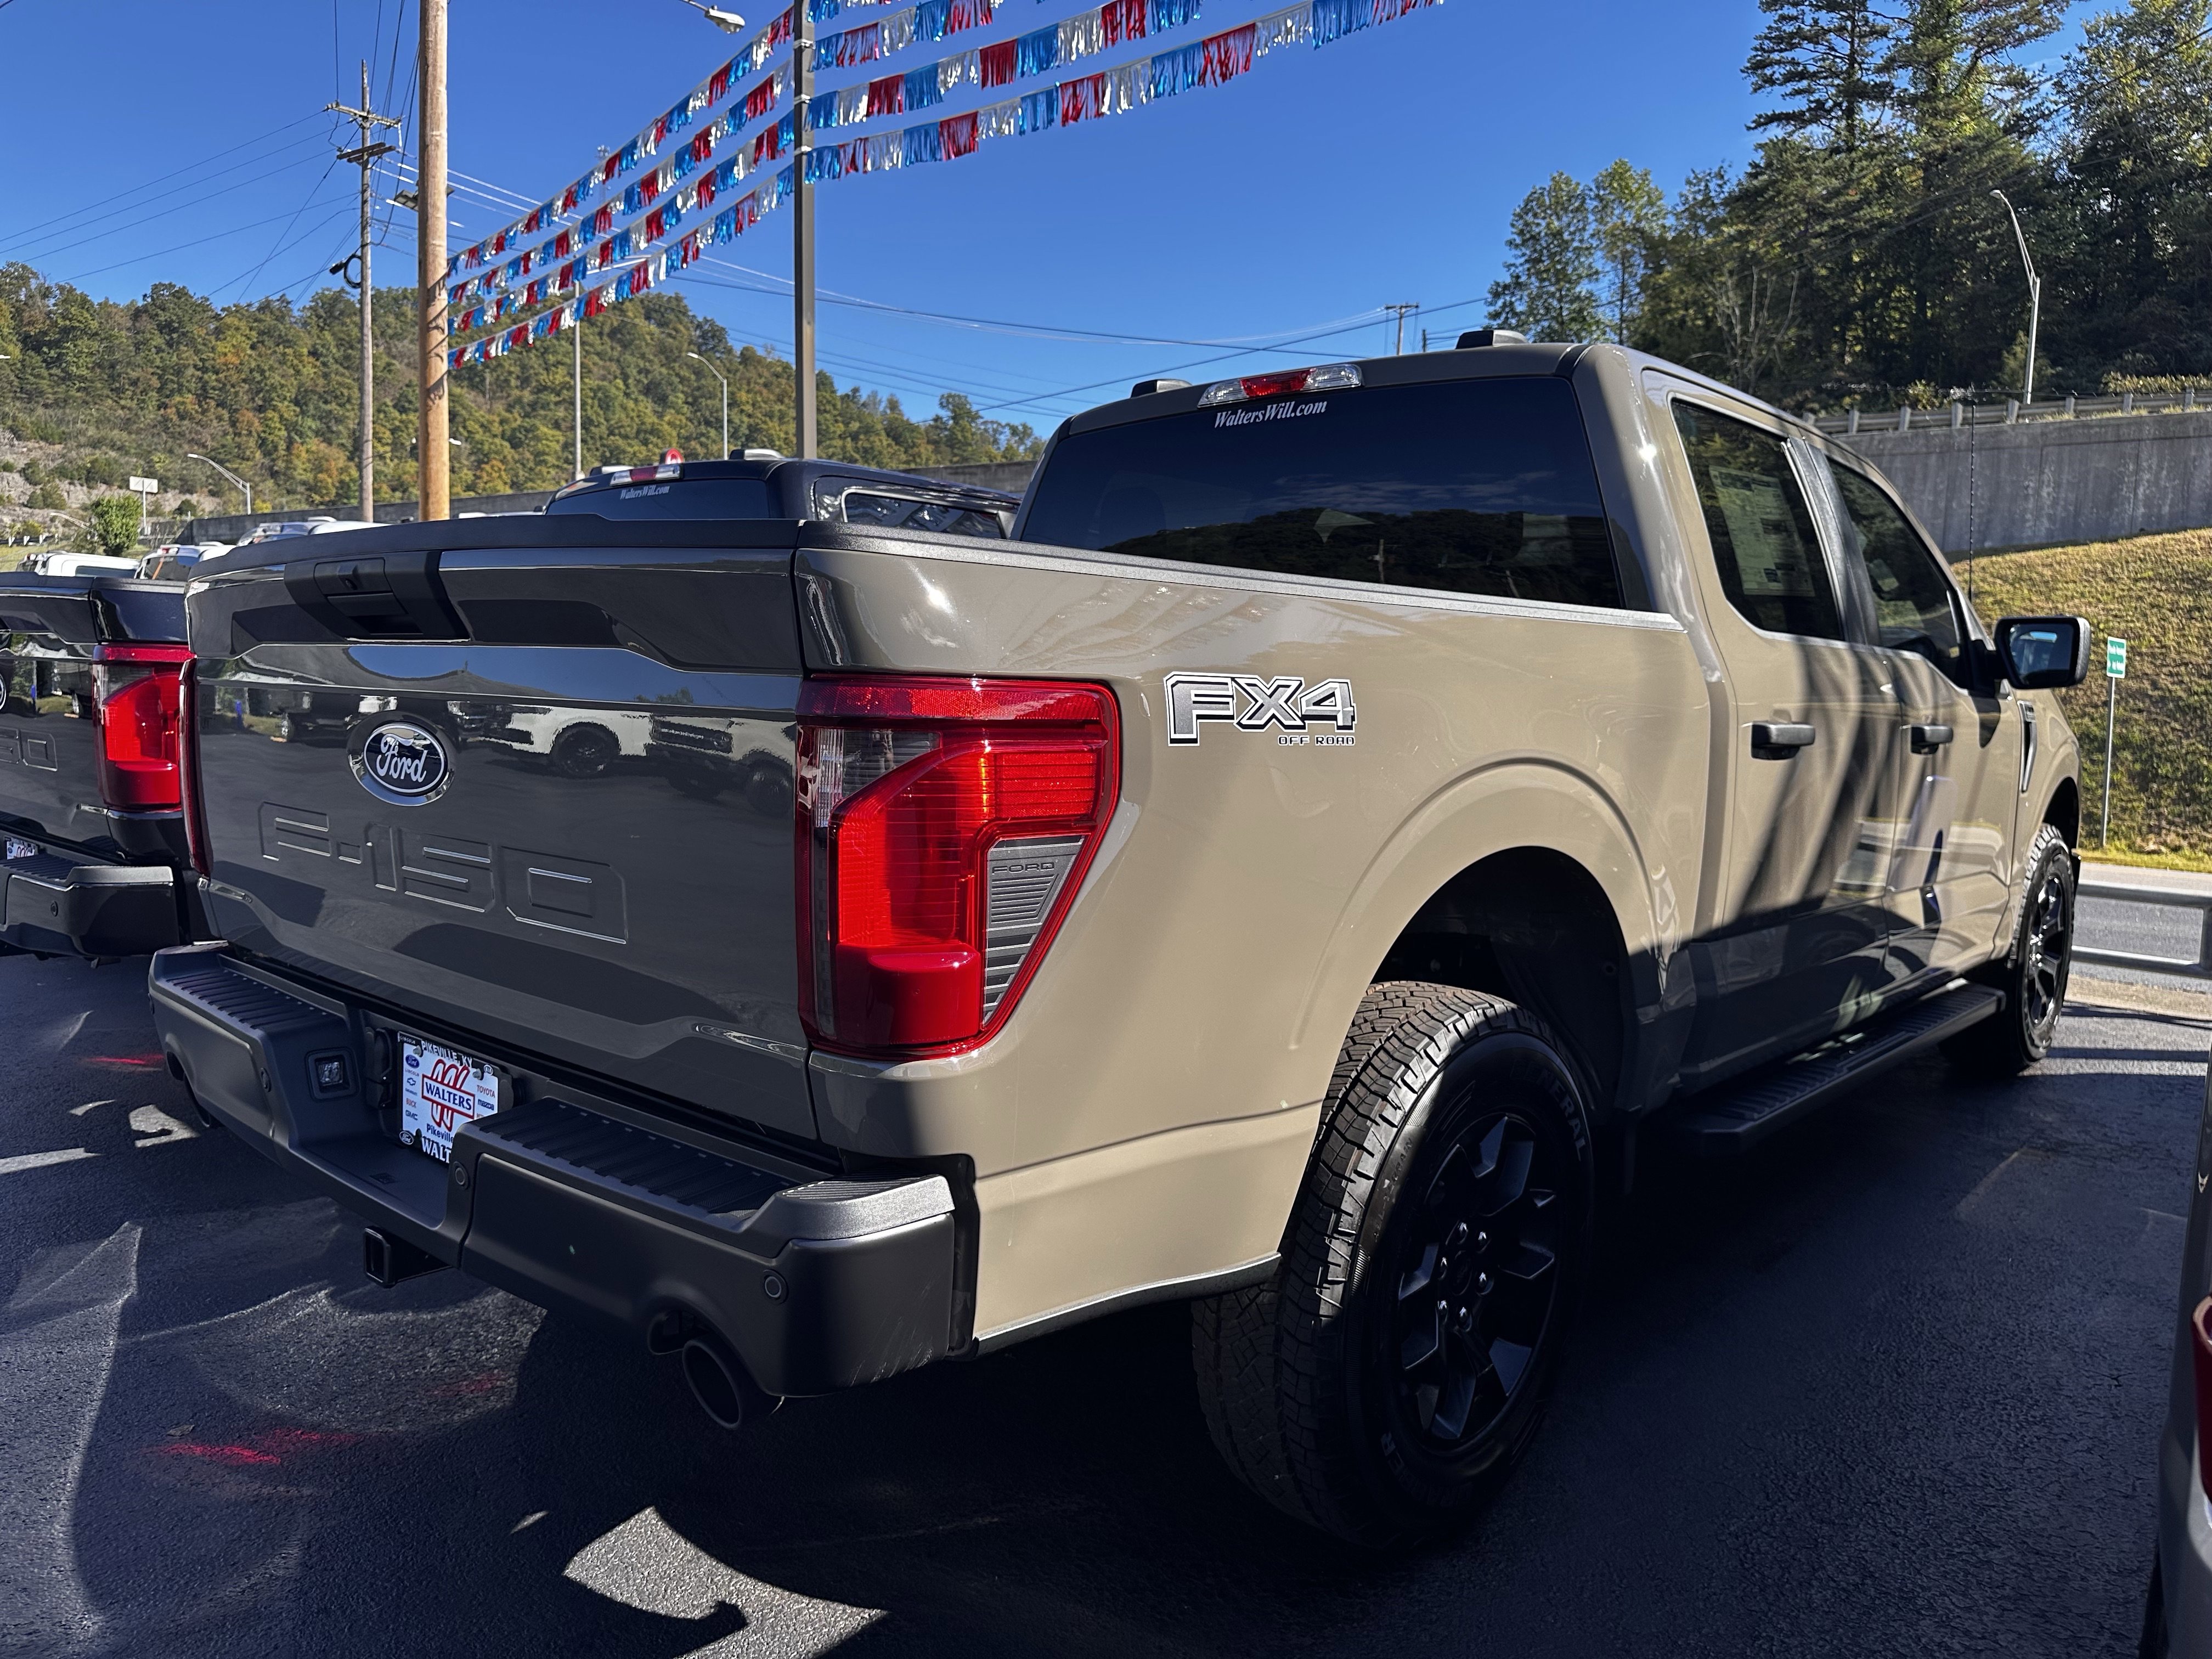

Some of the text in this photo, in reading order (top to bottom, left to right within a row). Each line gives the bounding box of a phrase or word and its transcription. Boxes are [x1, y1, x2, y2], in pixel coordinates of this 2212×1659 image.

[1214, 401, 1328, 428] WaltersWill.com
[620, 484, 670, 500] WaltersWill.com
[1163, 672, 1357, 746] FX4
[1278, 735, 1356, 746] OFF ROAD
[376, 732, 428, 783] Ford
[257, 801, 629, 945] F-150
[992, 861, 1055, 875] FORD
[421, 1040, 472, 1069] PIKEVILLE, KY
[425, 1081, 472, 1111] WALTERS
[477, 1084, 495, 1098] TOYOTA
[405, 1109, 418, 1121] GMC
[421, 1136, 452, 1164] WALT
